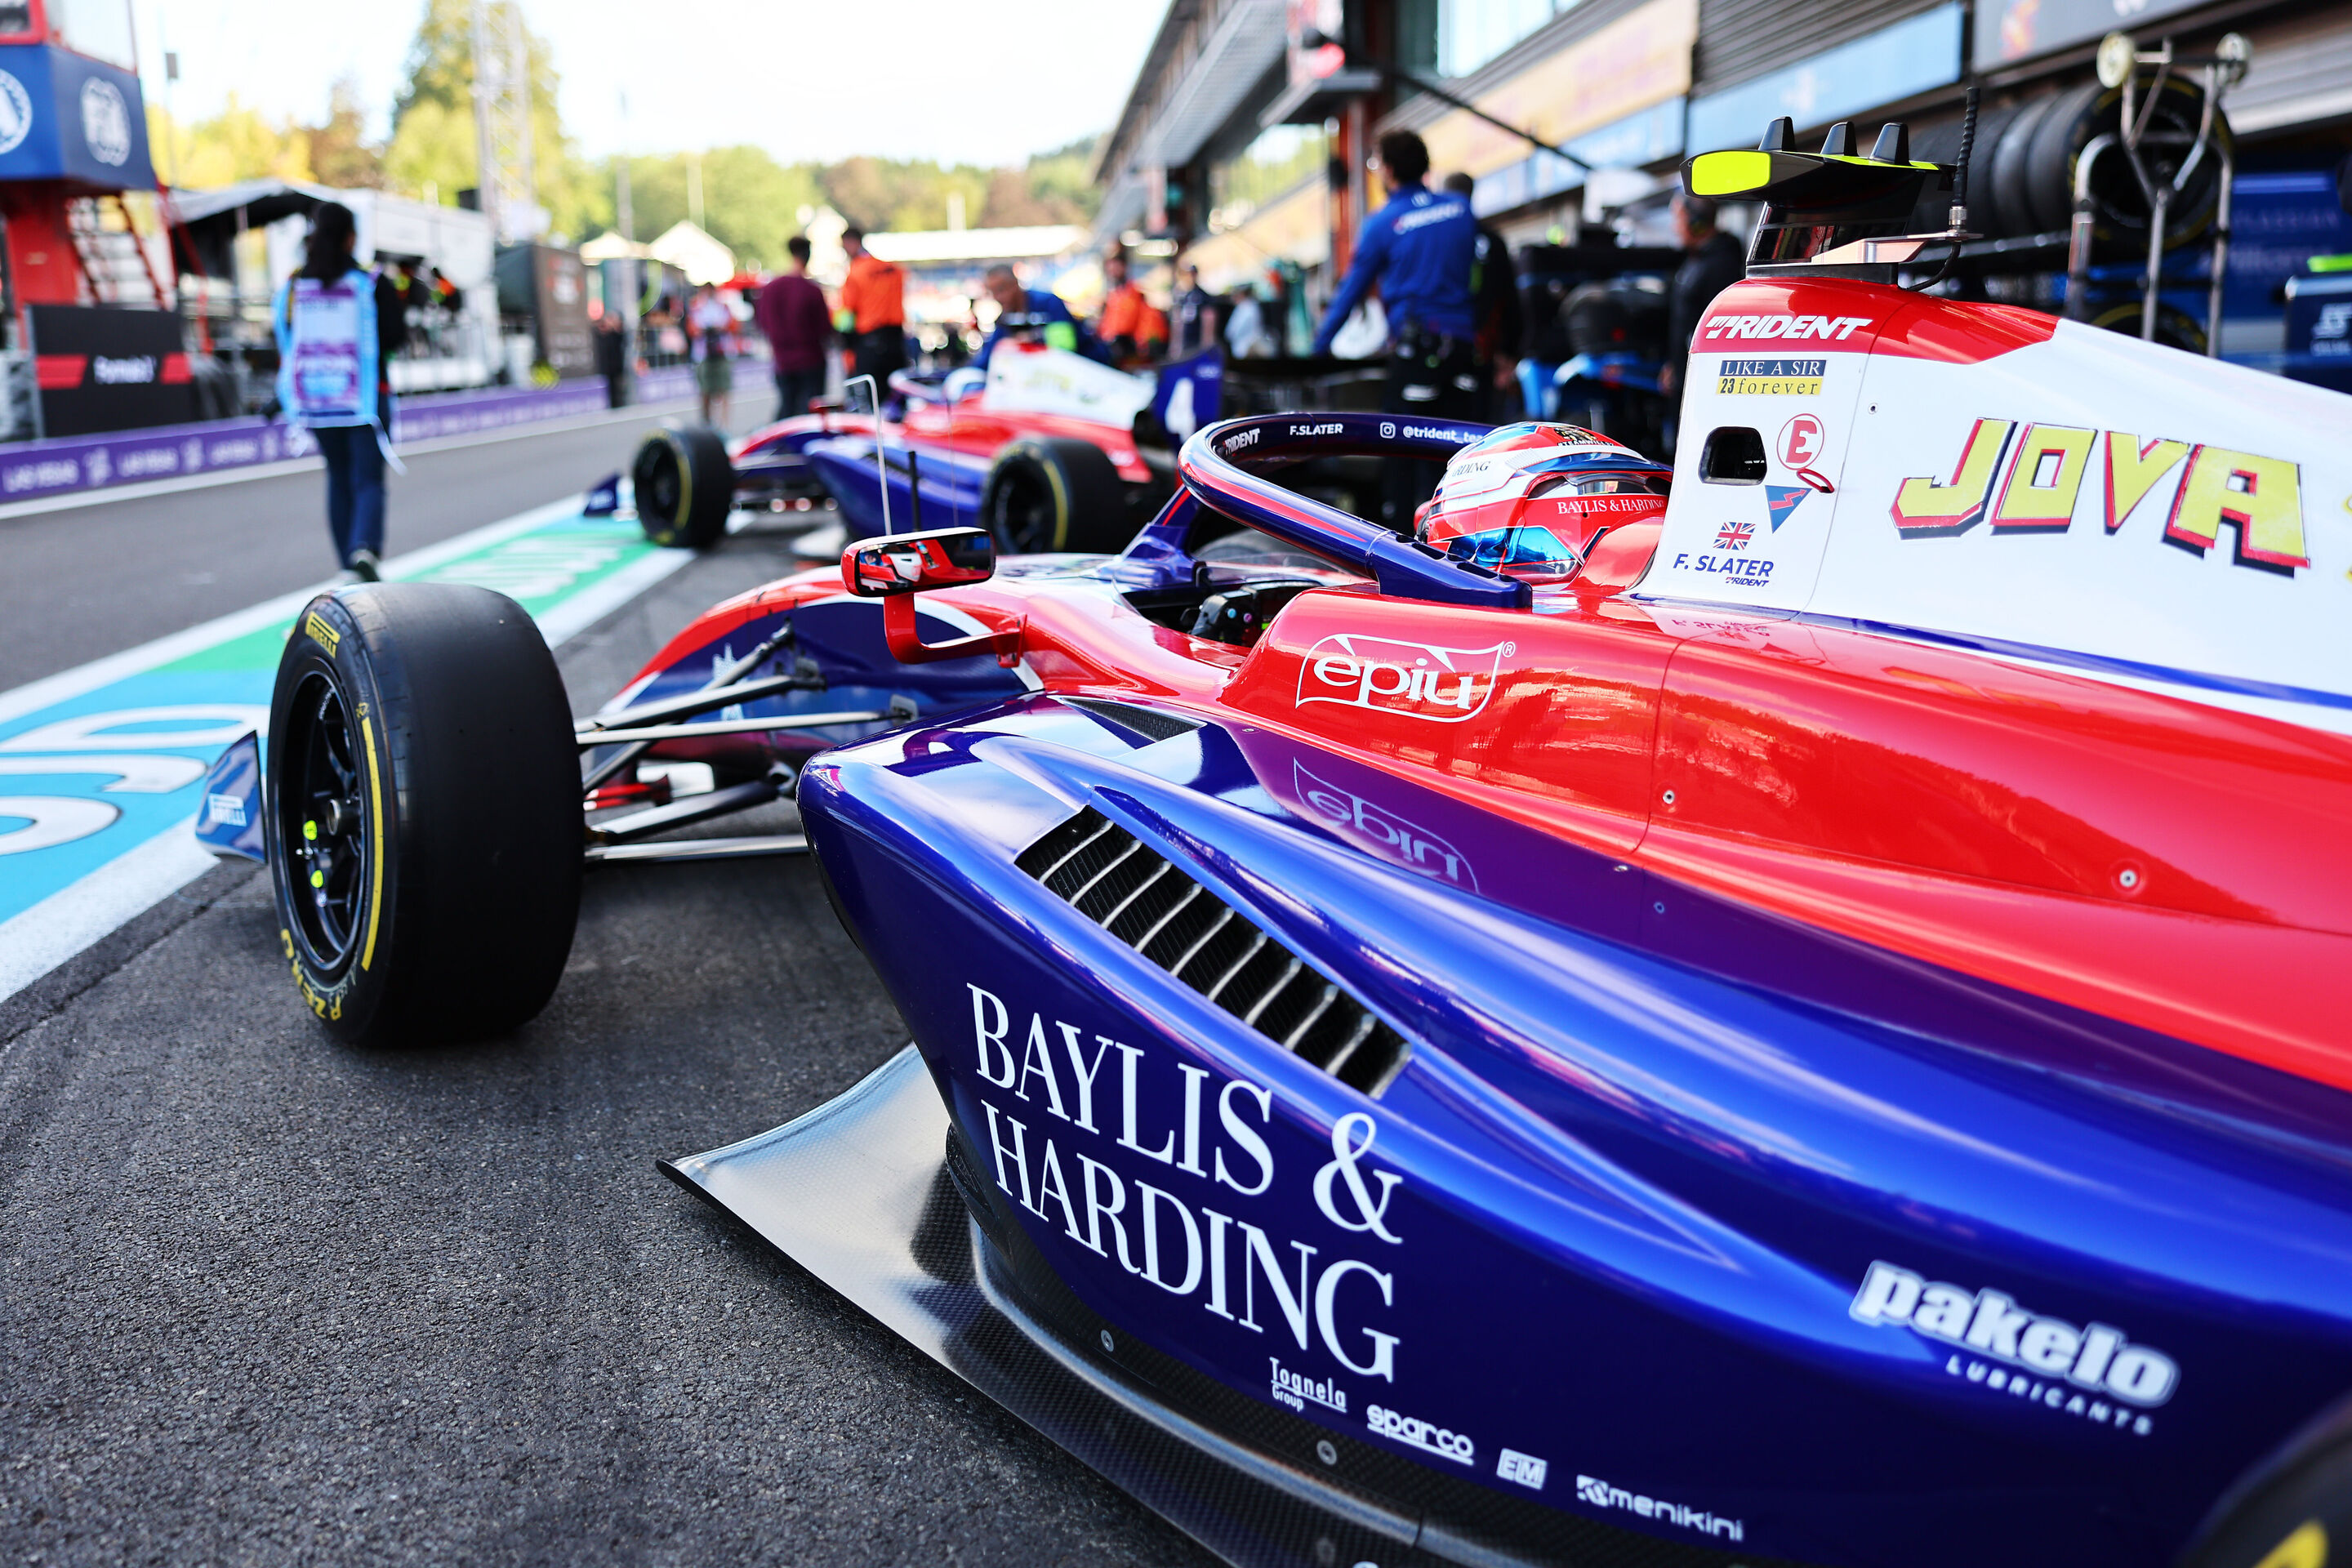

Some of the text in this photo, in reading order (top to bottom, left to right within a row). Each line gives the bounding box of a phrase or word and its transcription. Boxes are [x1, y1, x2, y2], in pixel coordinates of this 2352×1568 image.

[1705, 315, 1873, 341] TRIDENT
[1724, 361, 1820, 376] LIKE A SIR
[1557, 499, 1664, 514] BAYLIS & HARDING
[1889, 416, 2310, 578] JOVA
[1673, 553, 1775, 577] F. SLATER
[1725, 577, 1769, 588] TRIDENT
[967, 982, 1403, 1245] BAYLIS &
[981, 1099, 1401, 1383] HARDING
[1851, 1262, 2179, 1405] pakelo
[1269, 1356, 1347, 1410] Tognela
[1272, 1385, 1304, 1412] Group
[1945, 1353, 2154, 1436] LUBRICANTS
[1366, 1404, 1474, 1460] sparco
[1609, 1486, 1744, 1542] menikini
